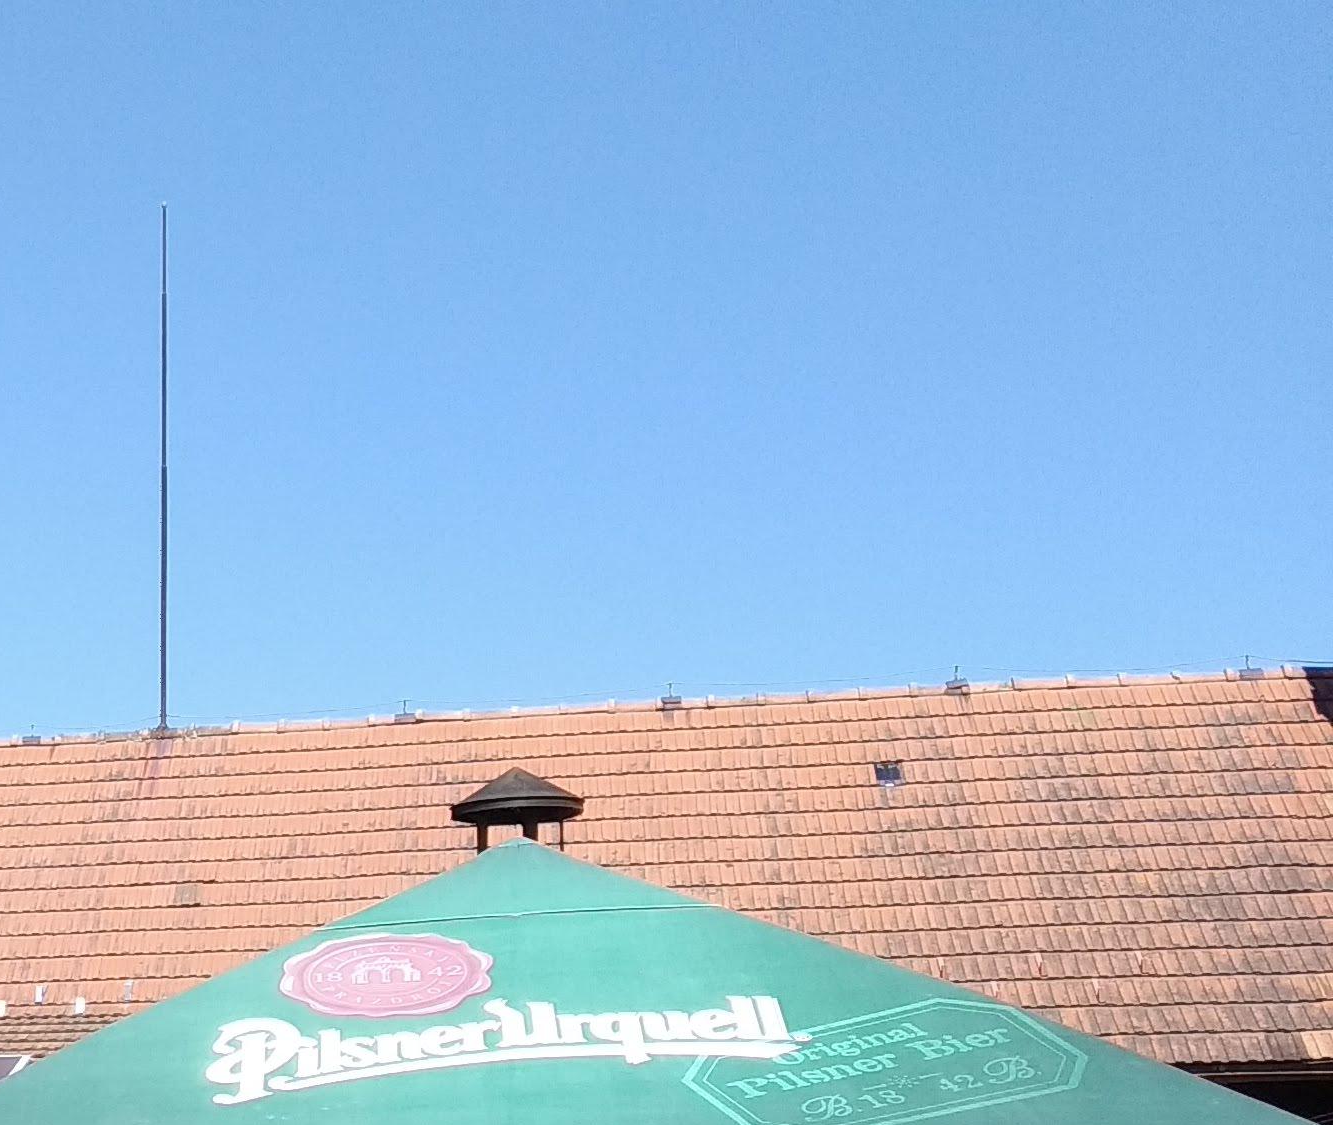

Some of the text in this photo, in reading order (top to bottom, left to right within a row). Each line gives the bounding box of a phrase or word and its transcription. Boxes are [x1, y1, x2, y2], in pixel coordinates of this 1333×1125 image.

[315, 965, 464, 983] 18 42
[205, 995, 789, 1105] Pilsner Urquell
[726, 1026, 1014, 1099] Pilsner Bier
[771, 1022, 929, 1066] Original
[863, 1089, 906, 1110] 18
[939, 1074, 983, 1094] 42
